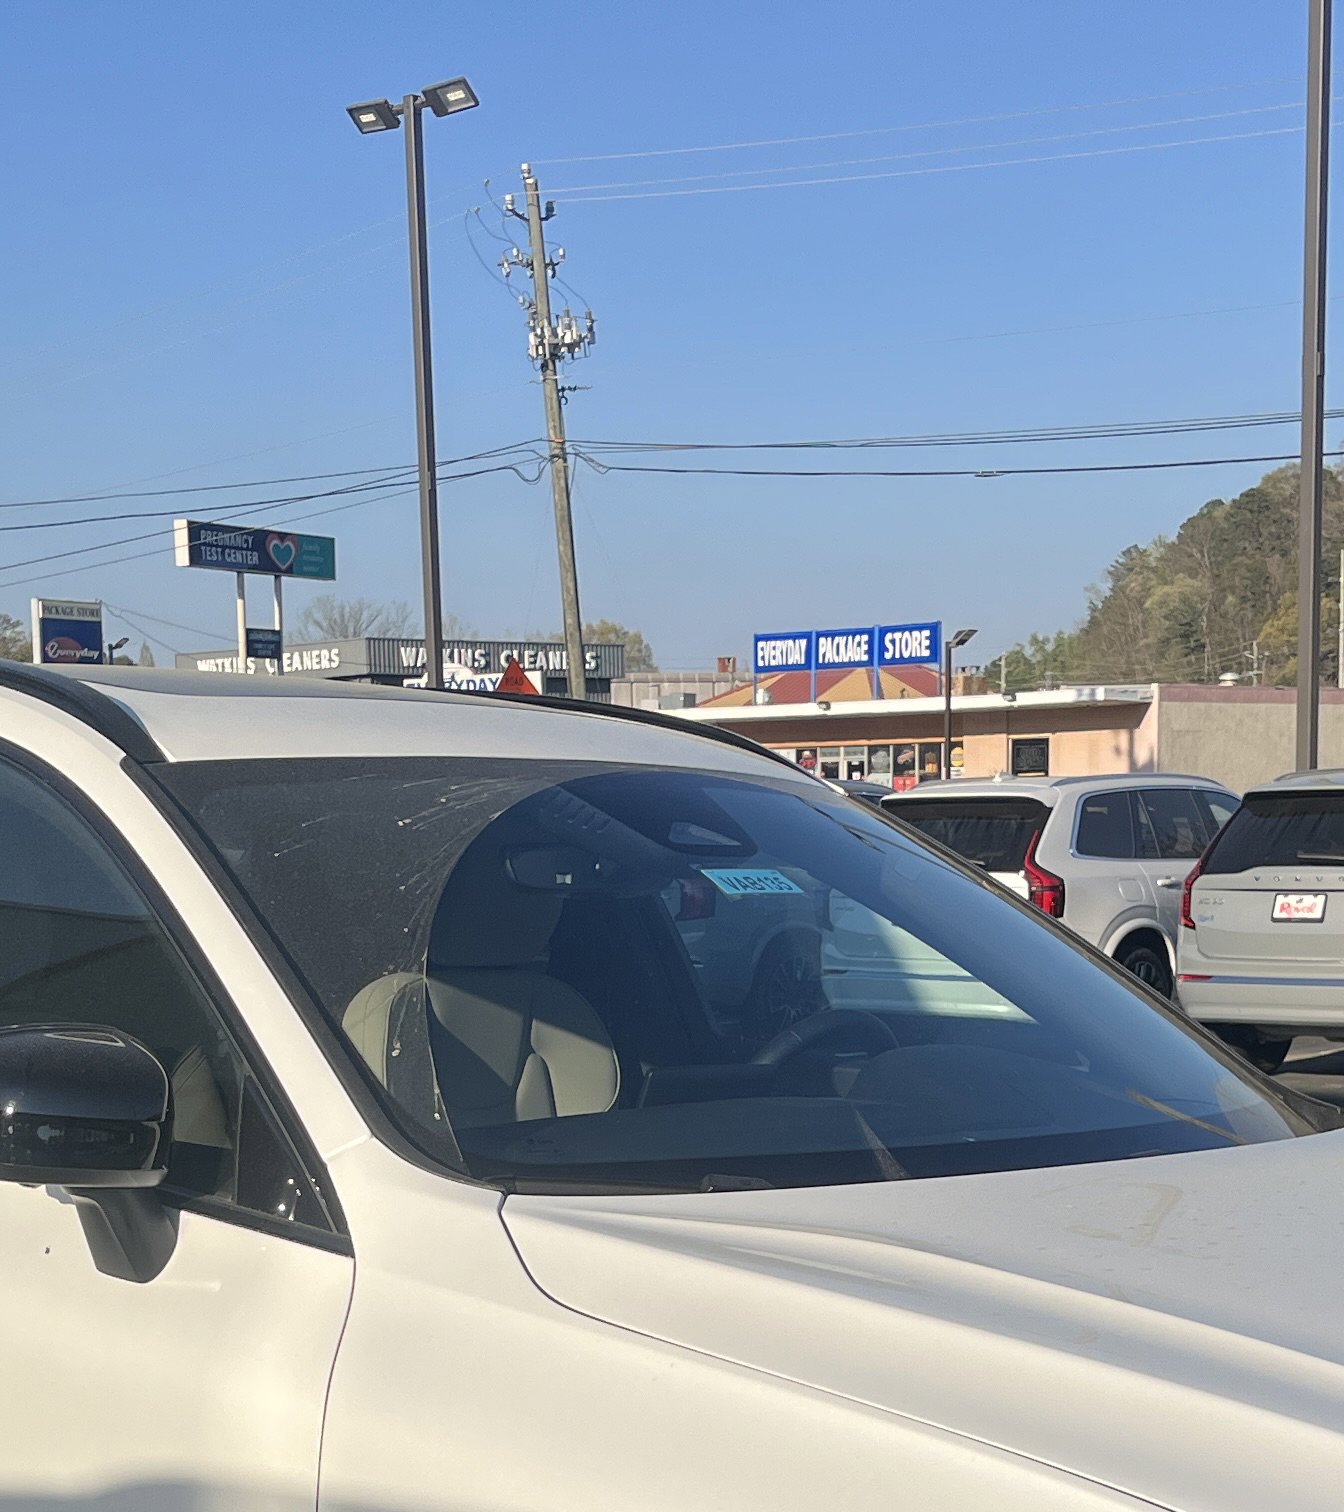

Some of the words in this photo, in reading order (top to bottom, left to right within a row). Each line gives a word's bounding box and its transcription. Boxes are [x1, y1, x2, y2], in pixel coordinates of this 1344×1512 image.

[200, 530, 254, 550] PREGNANCY
[200, 546, 223, 561] TEST
[224, 549, 260, 566] CENTER
[400, 646, 487, 669] WAKINS
[500, 648, 599, 671] CLEANES
[757, 638, 808, 667] EVERYDAY
[818, 634, 869, 664] PACKAGE
[883, 629, 931, 660] STORE
[264, 648, 341, 676] CEANERS
